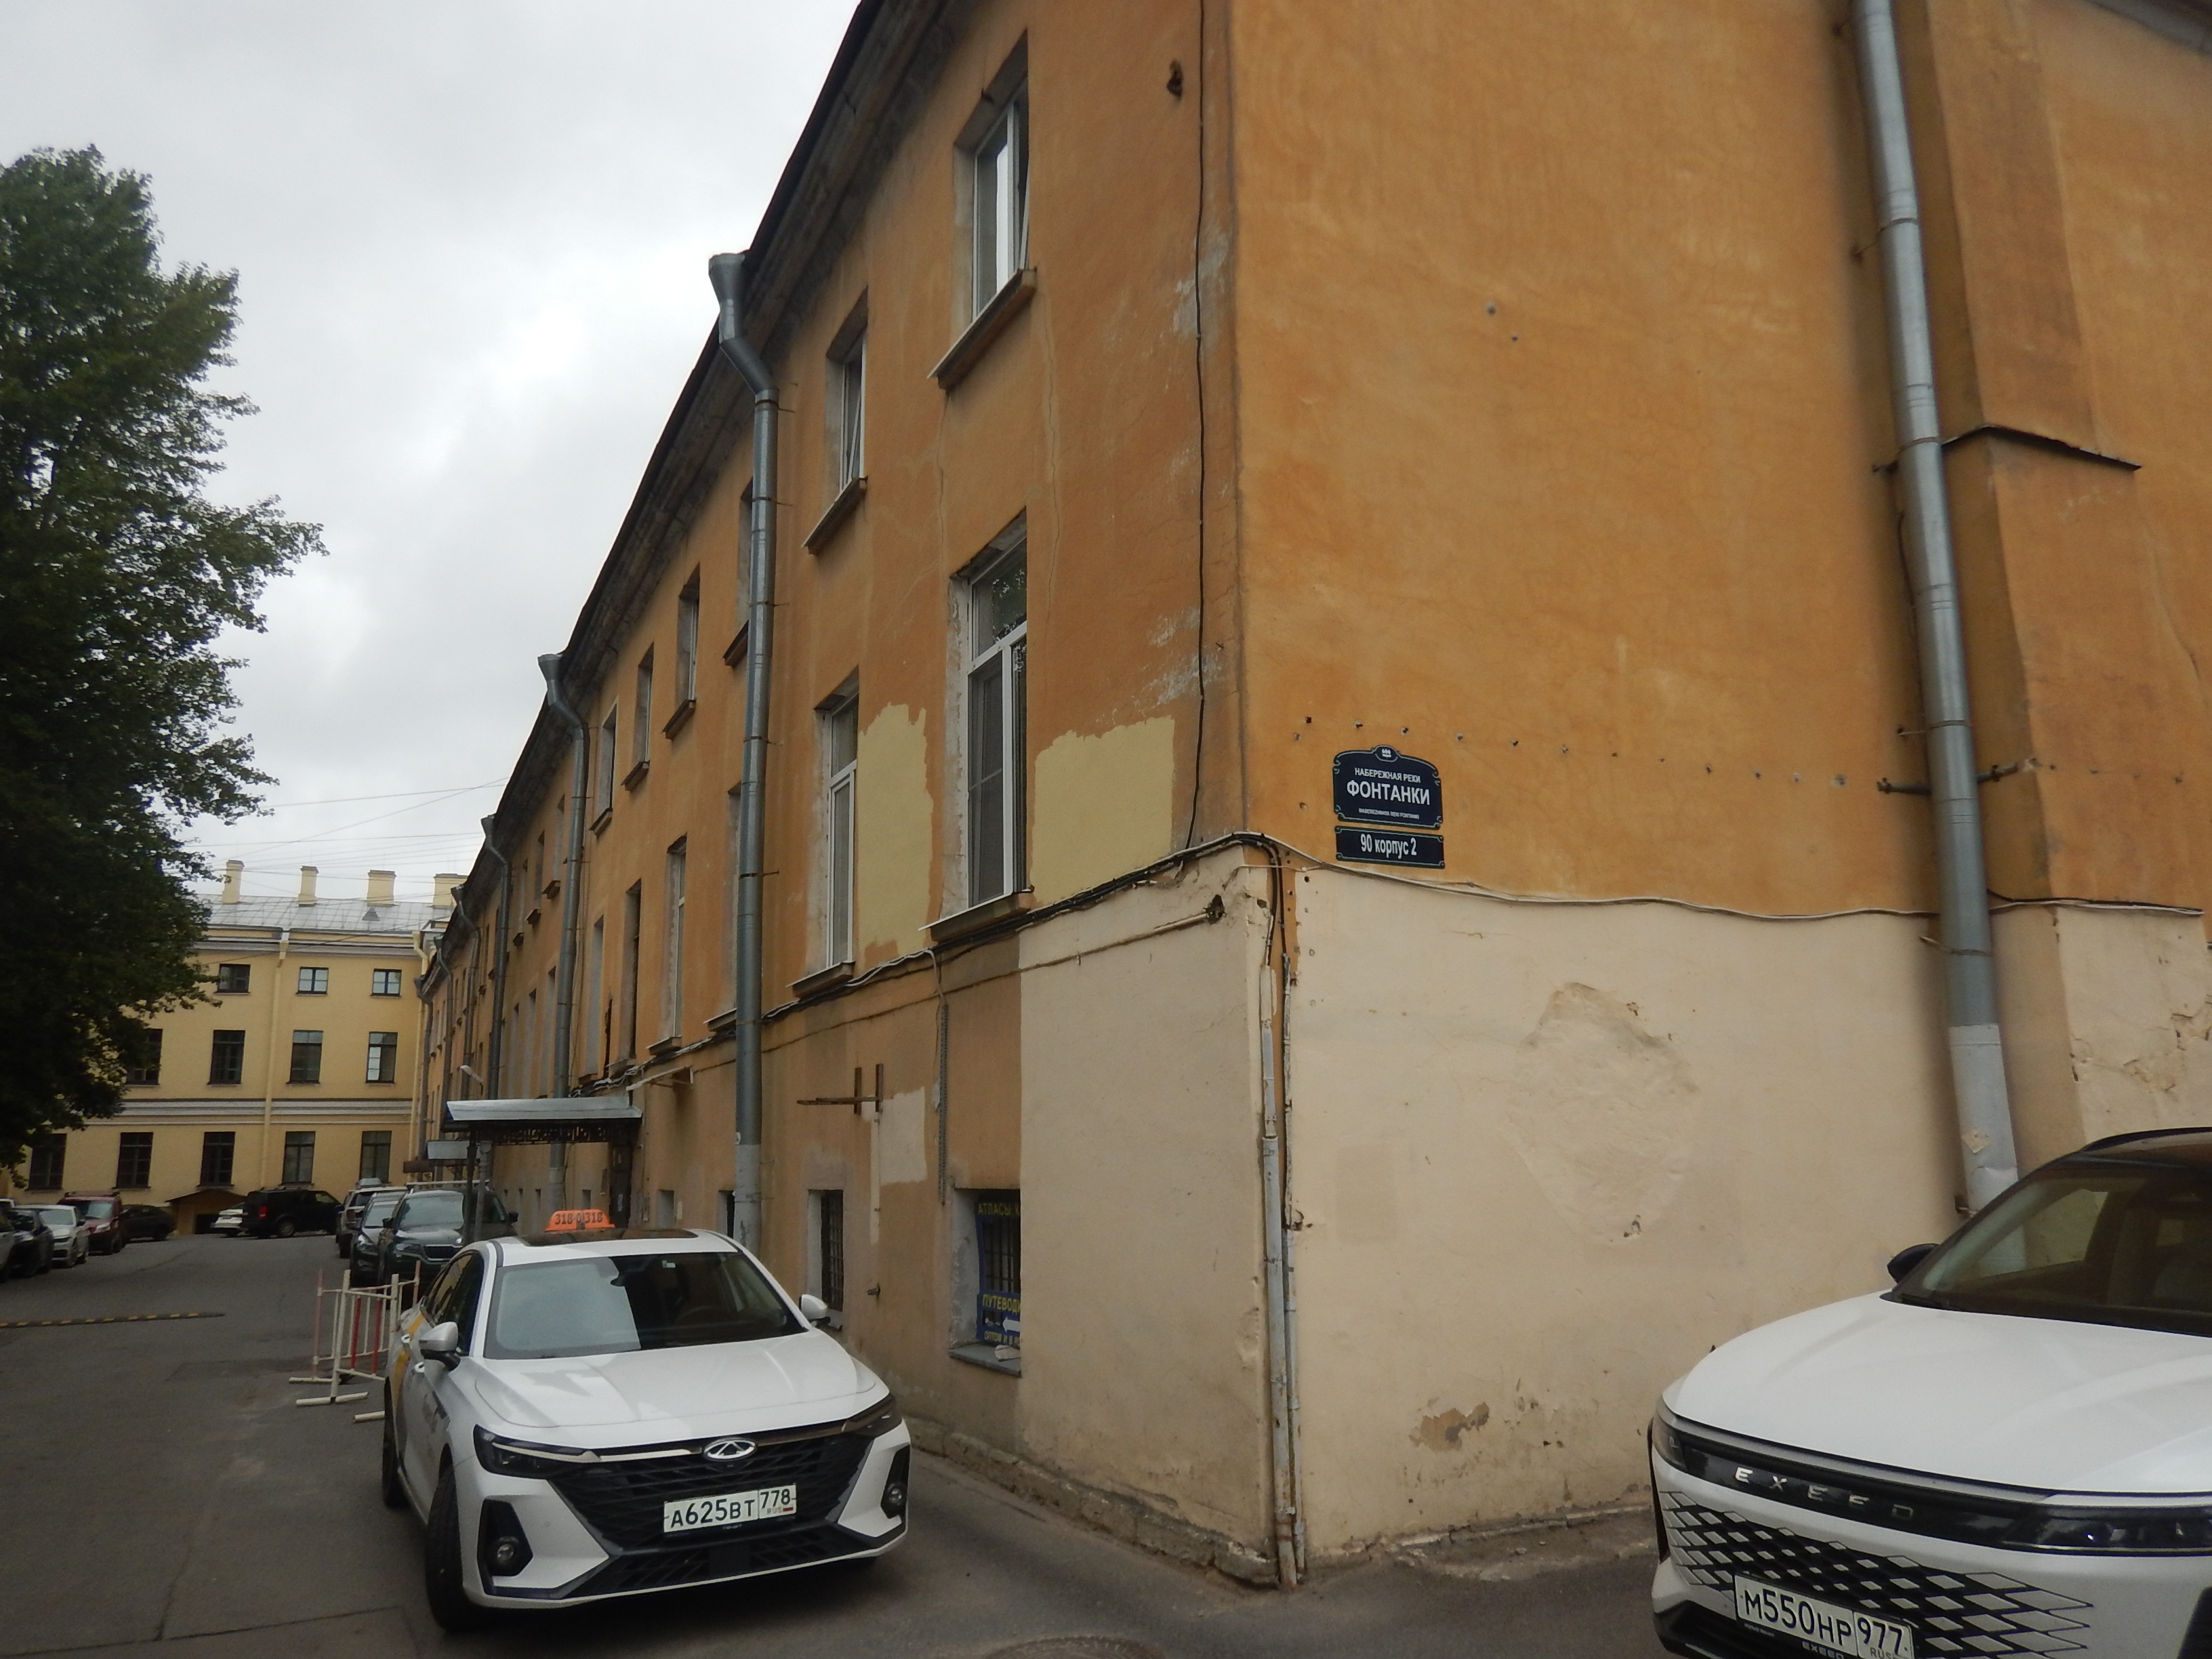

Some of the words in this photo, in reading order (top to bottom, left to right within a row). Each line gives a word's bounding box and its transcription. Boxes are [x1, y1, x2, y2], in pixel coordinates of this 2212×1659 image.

[1355, 767, 1402, 781] НАБЕРЕЖНАЯ
[1404, 773, 1421, 783] РЕКИ
[1347, 779, 1431, 805] ФОНТАНКИ
[1360, 834, 1372, 853] 90
[1375, 838, 1409, 859] корпус
[1410, 837, 1417, 856] 2
[670, 1498, 755, 1528] А625ВТ
[760, 1488, 791, 1509] 778
[1744, 1589, 1852, 1647] М550НР
[1857, 1617, 1902, 1655] 977
